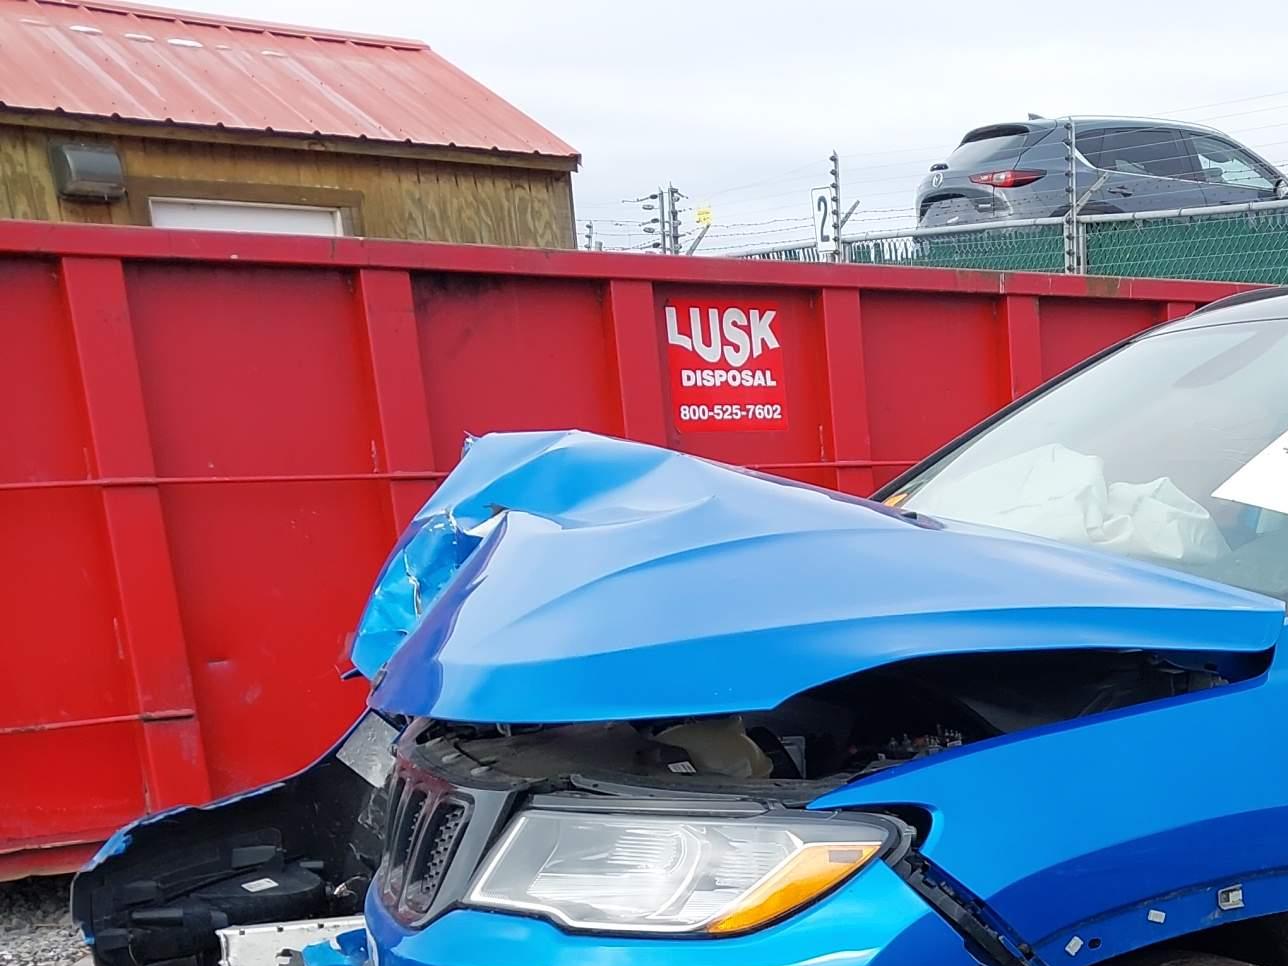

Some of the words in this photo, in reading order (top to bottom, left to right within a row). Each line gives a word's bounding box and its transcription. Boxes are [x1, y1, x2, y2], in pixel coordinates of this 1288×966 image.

[817, 195, 830, 242] 2
[665, 306, 780, 367] LUSK
[681, 369, 777, 387] DISPOSAL
[680, 404, 782, 421] 800-525-7602
